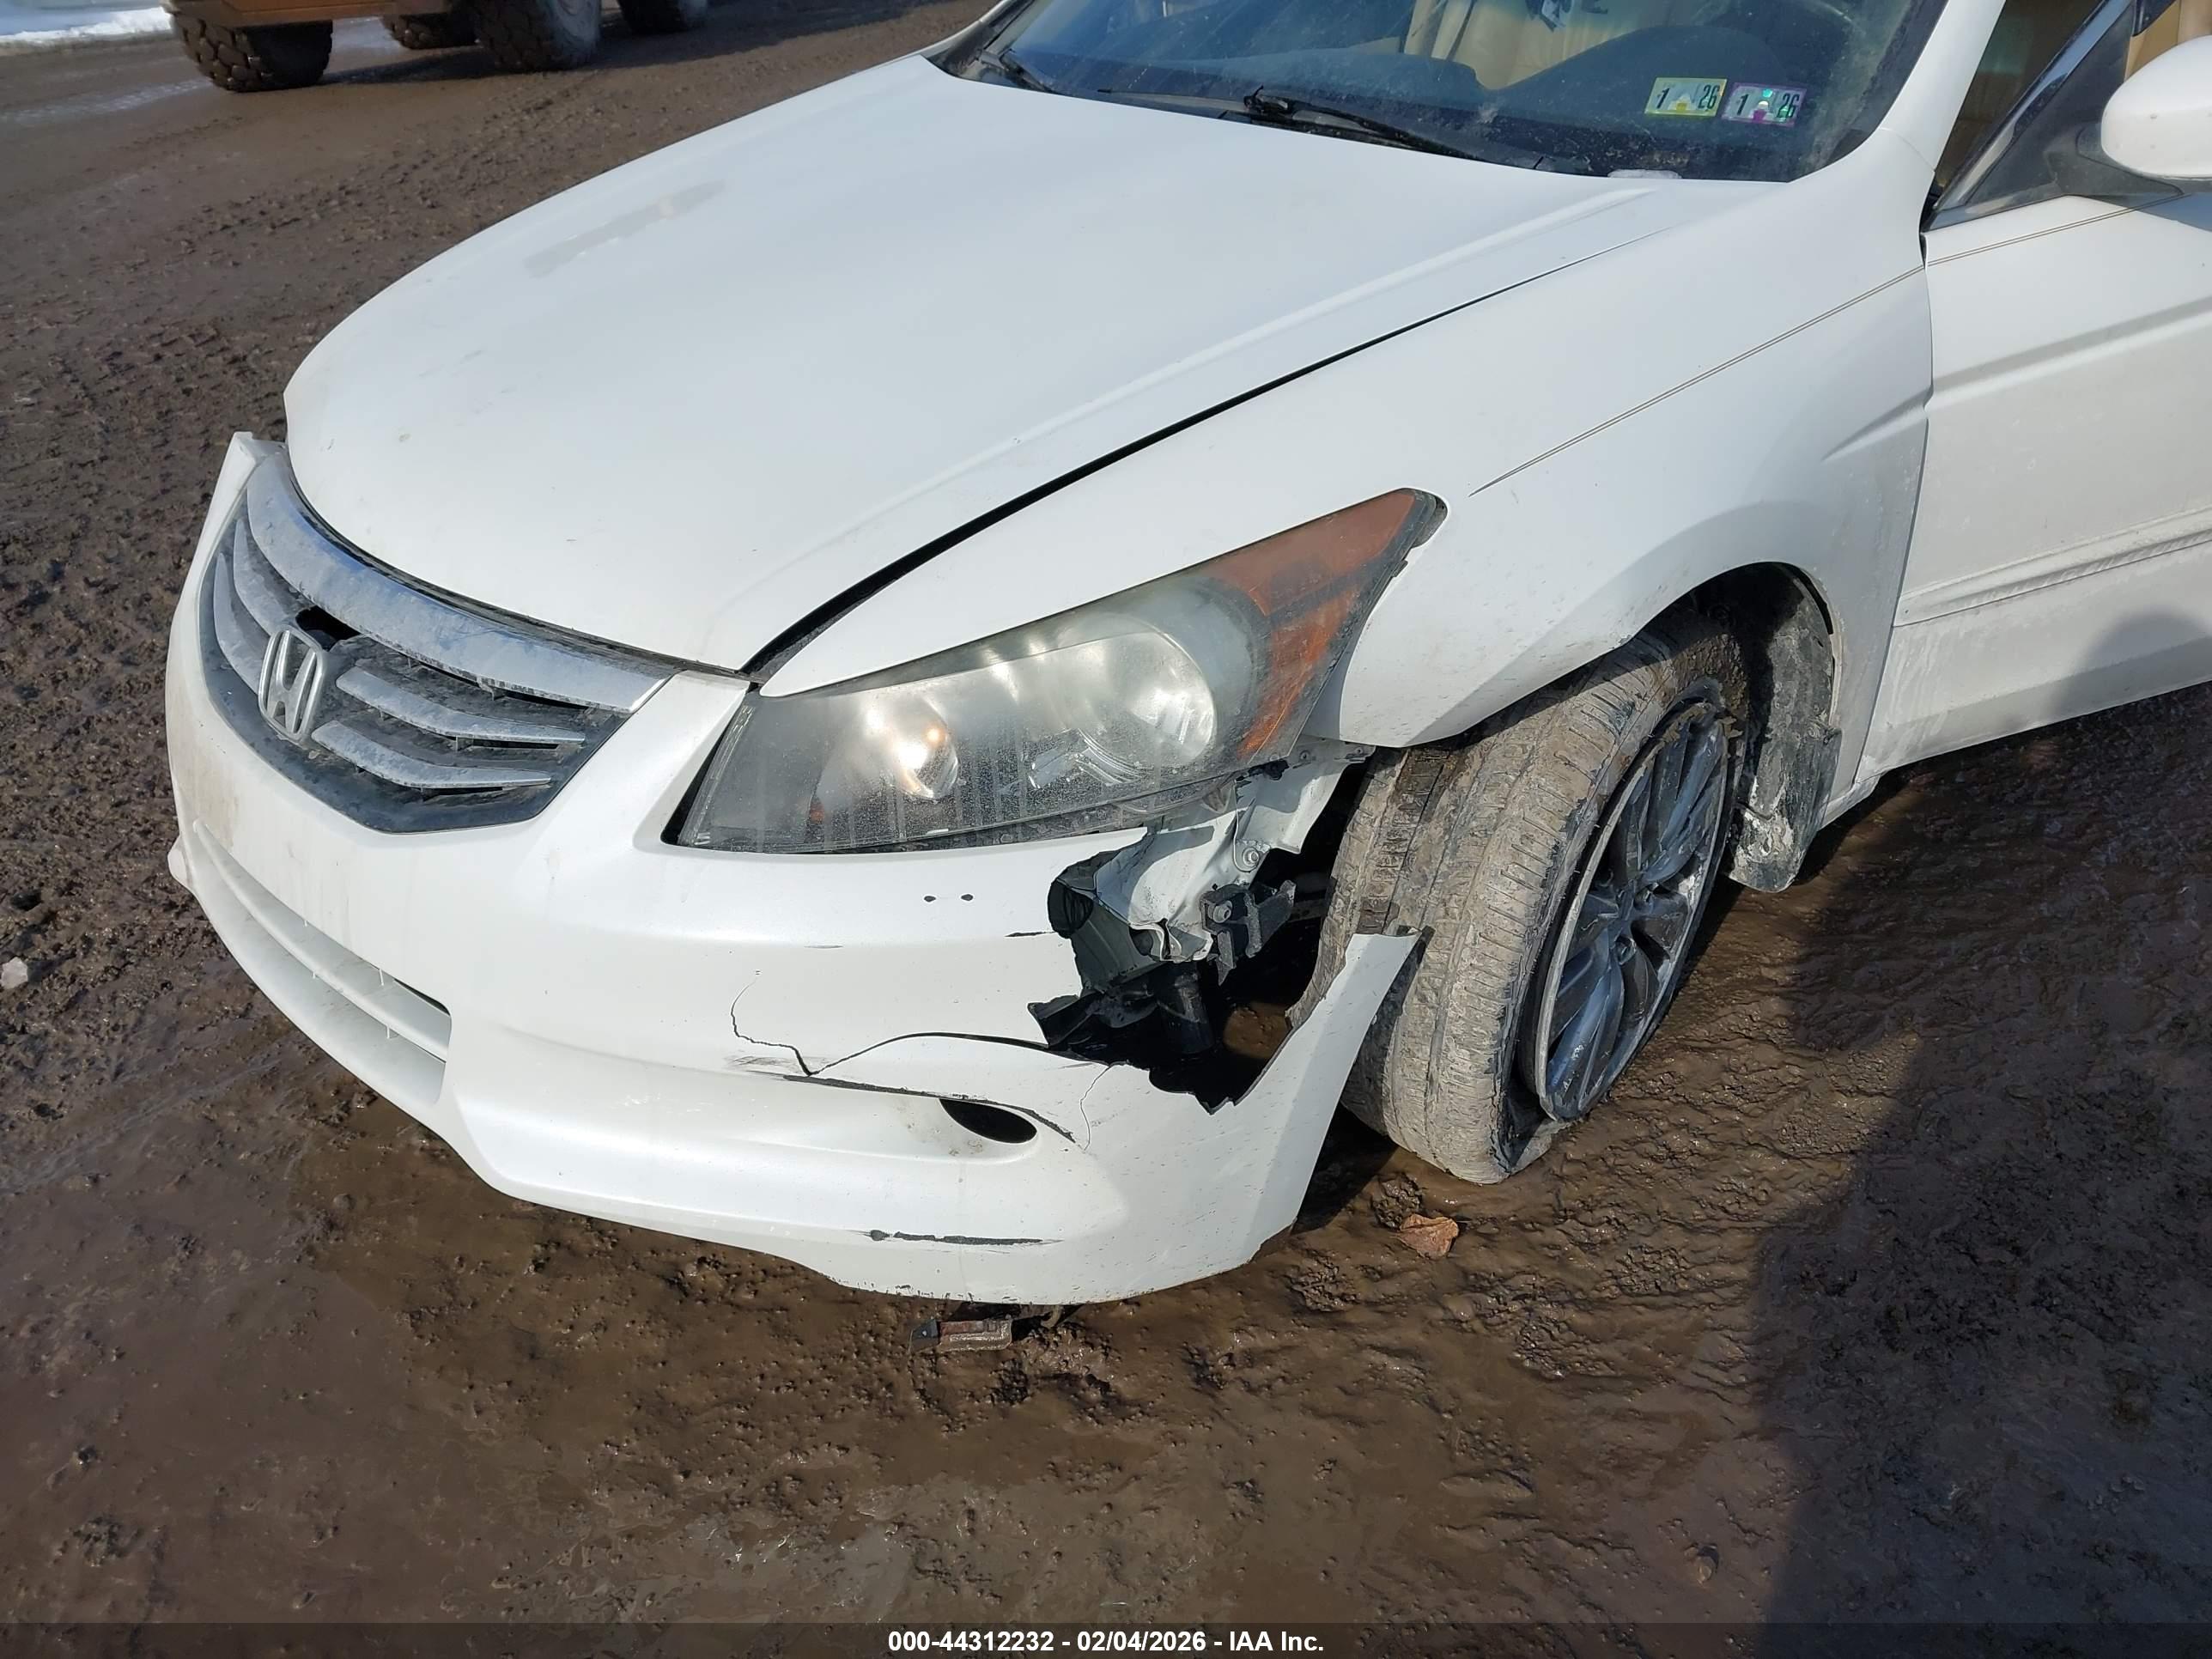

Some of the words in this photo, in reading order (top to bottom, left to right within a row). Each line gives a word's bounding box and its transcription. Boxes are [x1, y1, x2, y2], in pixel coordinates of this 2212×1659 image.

[1656, 88, 1670, 109] 1
[1698, 84, 1721, 109] 26
[1736, 94, 1750, 116] 1
[1777, 93, 1801, 118] 26
